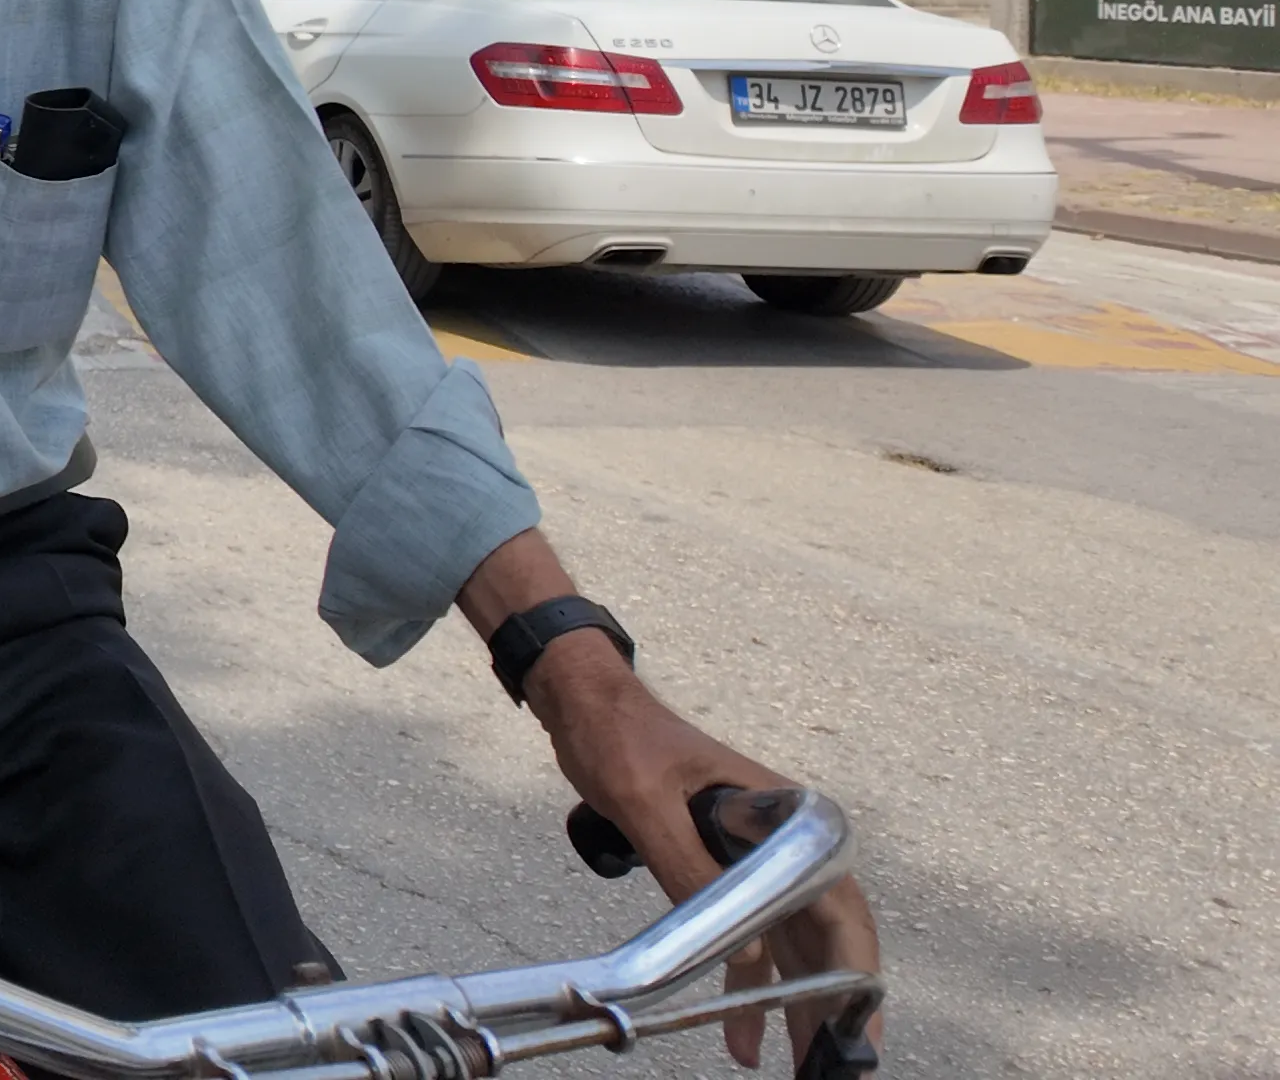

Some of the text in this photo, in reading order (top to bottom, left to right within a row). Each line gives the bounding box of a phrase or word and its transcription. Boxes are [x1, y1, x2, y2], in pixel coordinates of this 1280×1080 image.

[1172, 4, 1216, 24] ANA
[1220, 4, 1276, 27] BAYİİ
[612, 38, 626, 48] E
[750, 82, 897, 115] 34 JZ 2879
